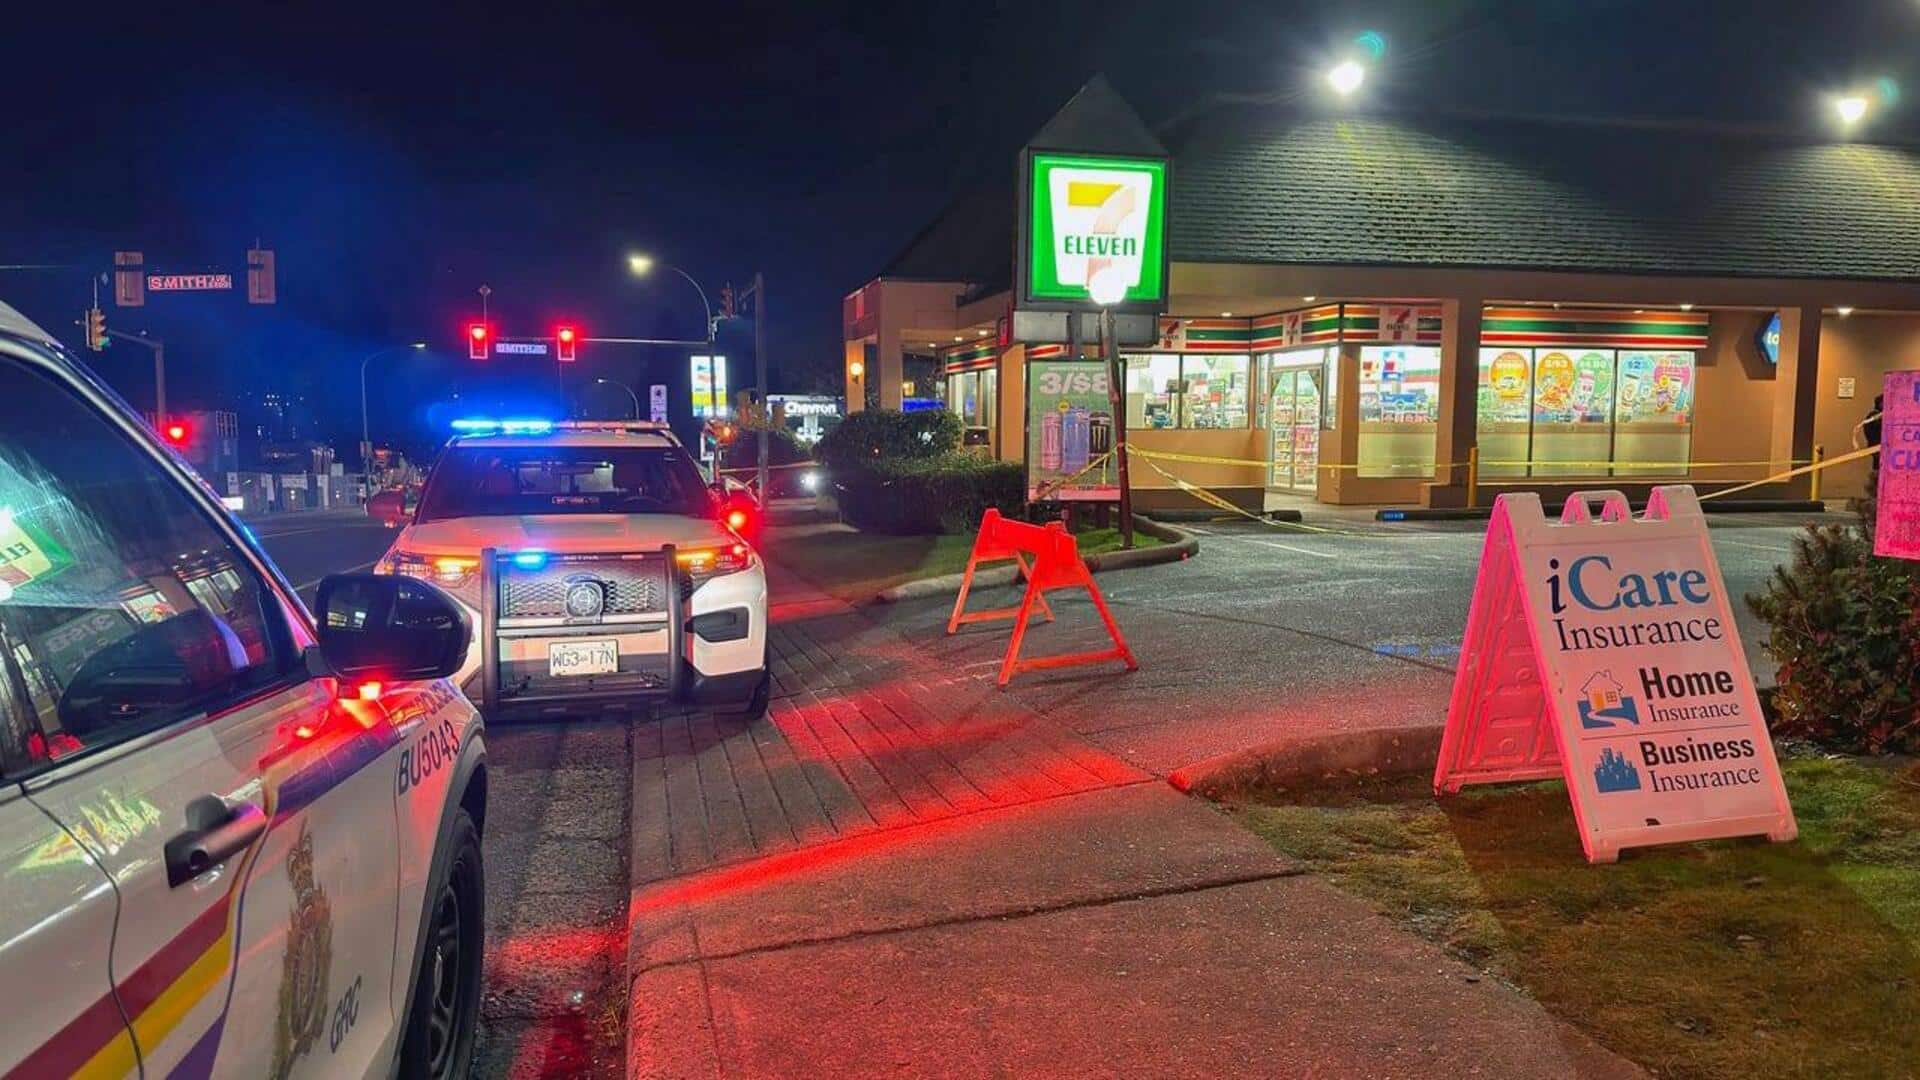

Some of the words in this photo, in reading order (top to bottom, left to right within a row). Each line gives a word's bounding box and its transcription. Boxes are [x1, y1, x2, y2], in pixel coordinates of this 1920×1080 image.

[150, 275, 207, 289] SMITH
[784, 401, 837, 414] Chevron
[1546, 555, 1711, 614] iCare
[1552, 616, 1723, 652] Insurance
[1639, 666, 1734, 701] Home
[1649, 701, 1740, 723] Insurance
[398, 719, 460, 796] BU5043
[1639, 737, 1755, 767] Business
[1649, 767, 1761, 793] Insurance
